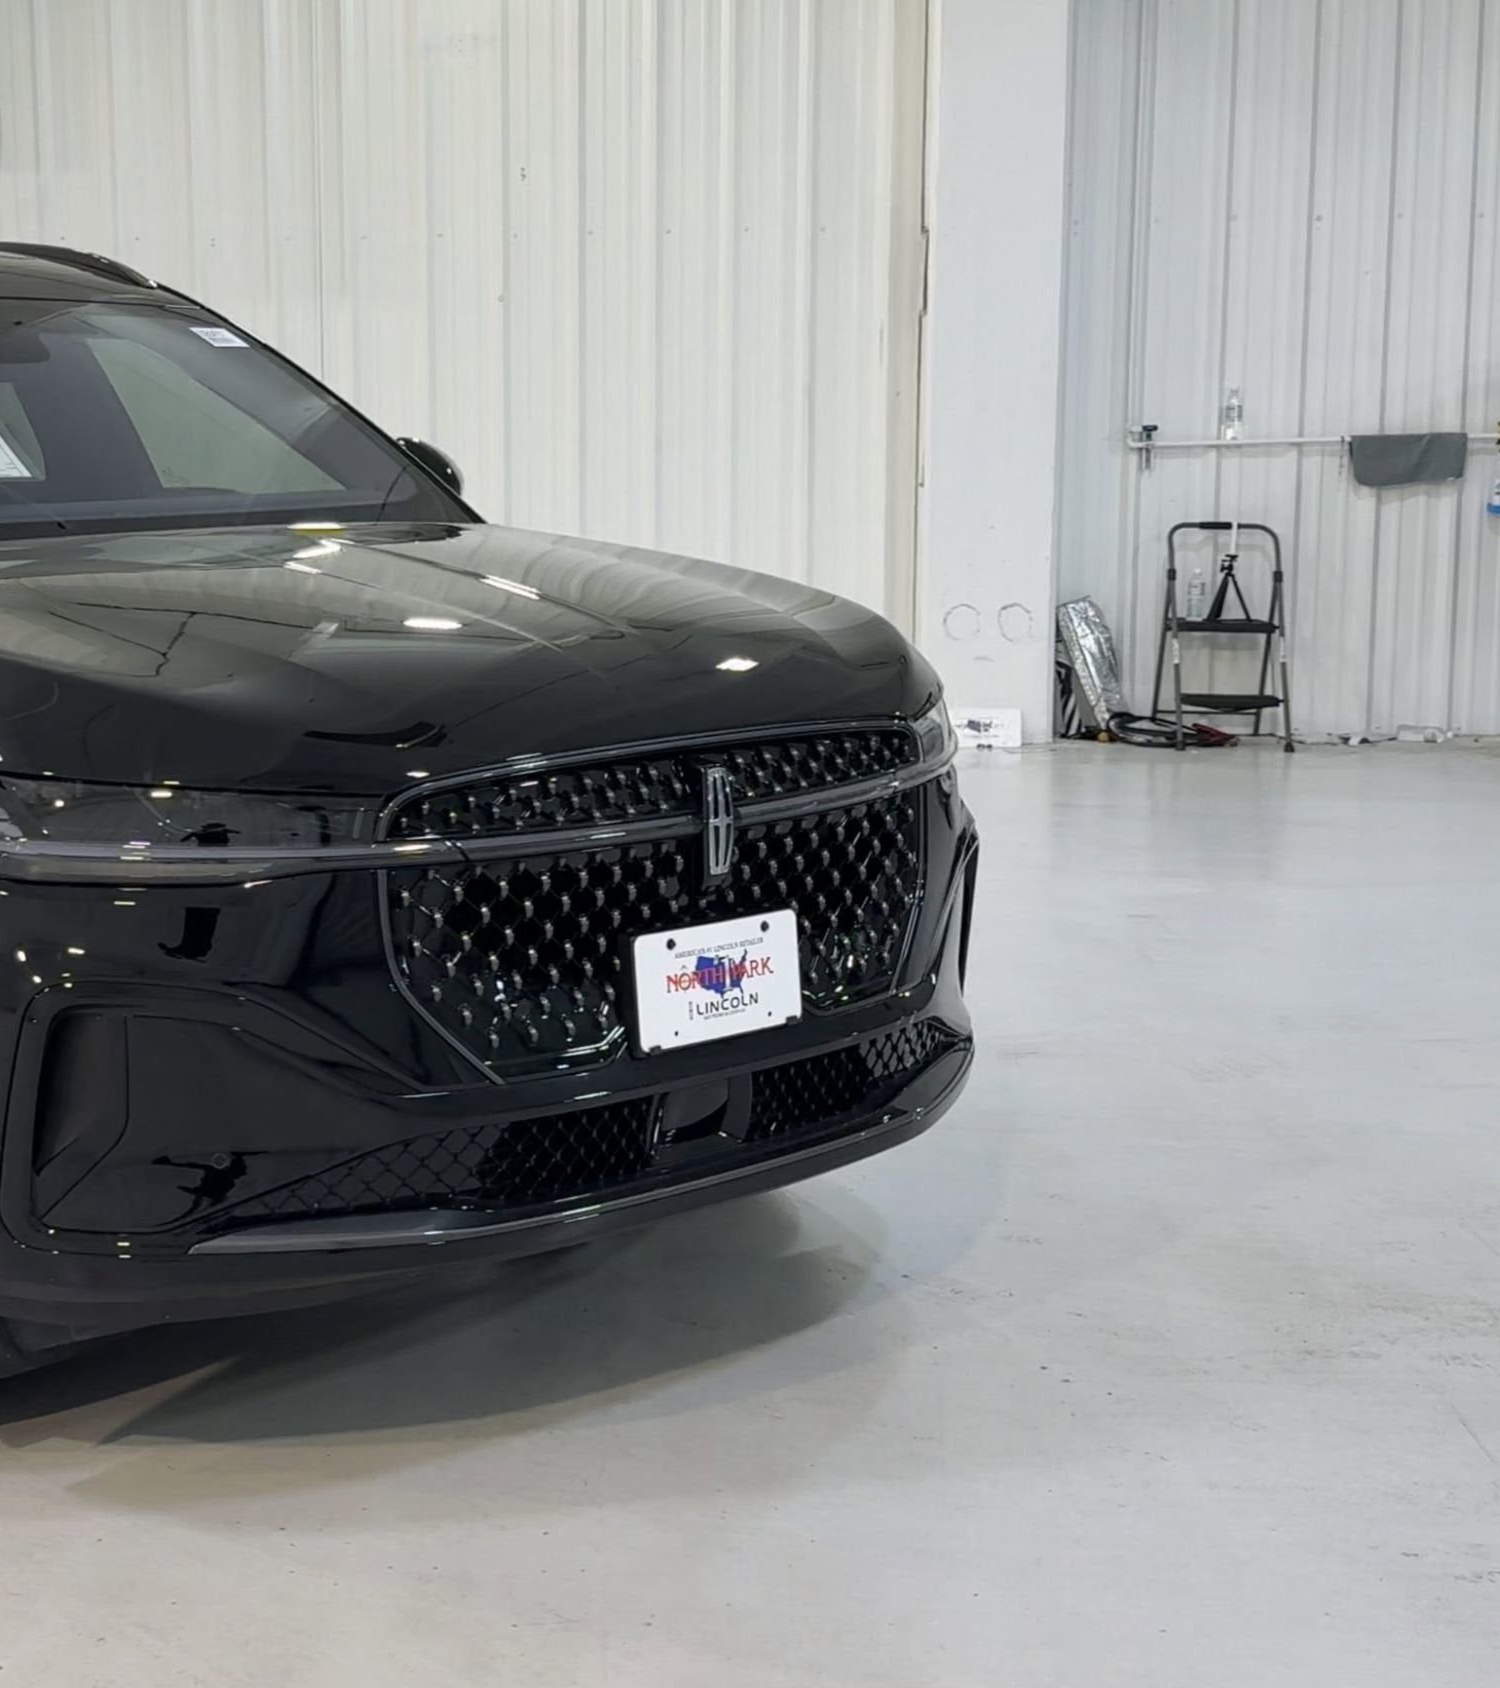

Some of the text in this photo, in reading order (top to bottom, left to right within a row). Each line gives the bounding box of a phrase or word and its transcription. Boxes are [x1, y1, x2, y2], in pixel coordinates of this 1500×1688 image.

[666, 956, 775, 994] NORTH PARK
[696, 992, 759, 1016] LINCOLN
